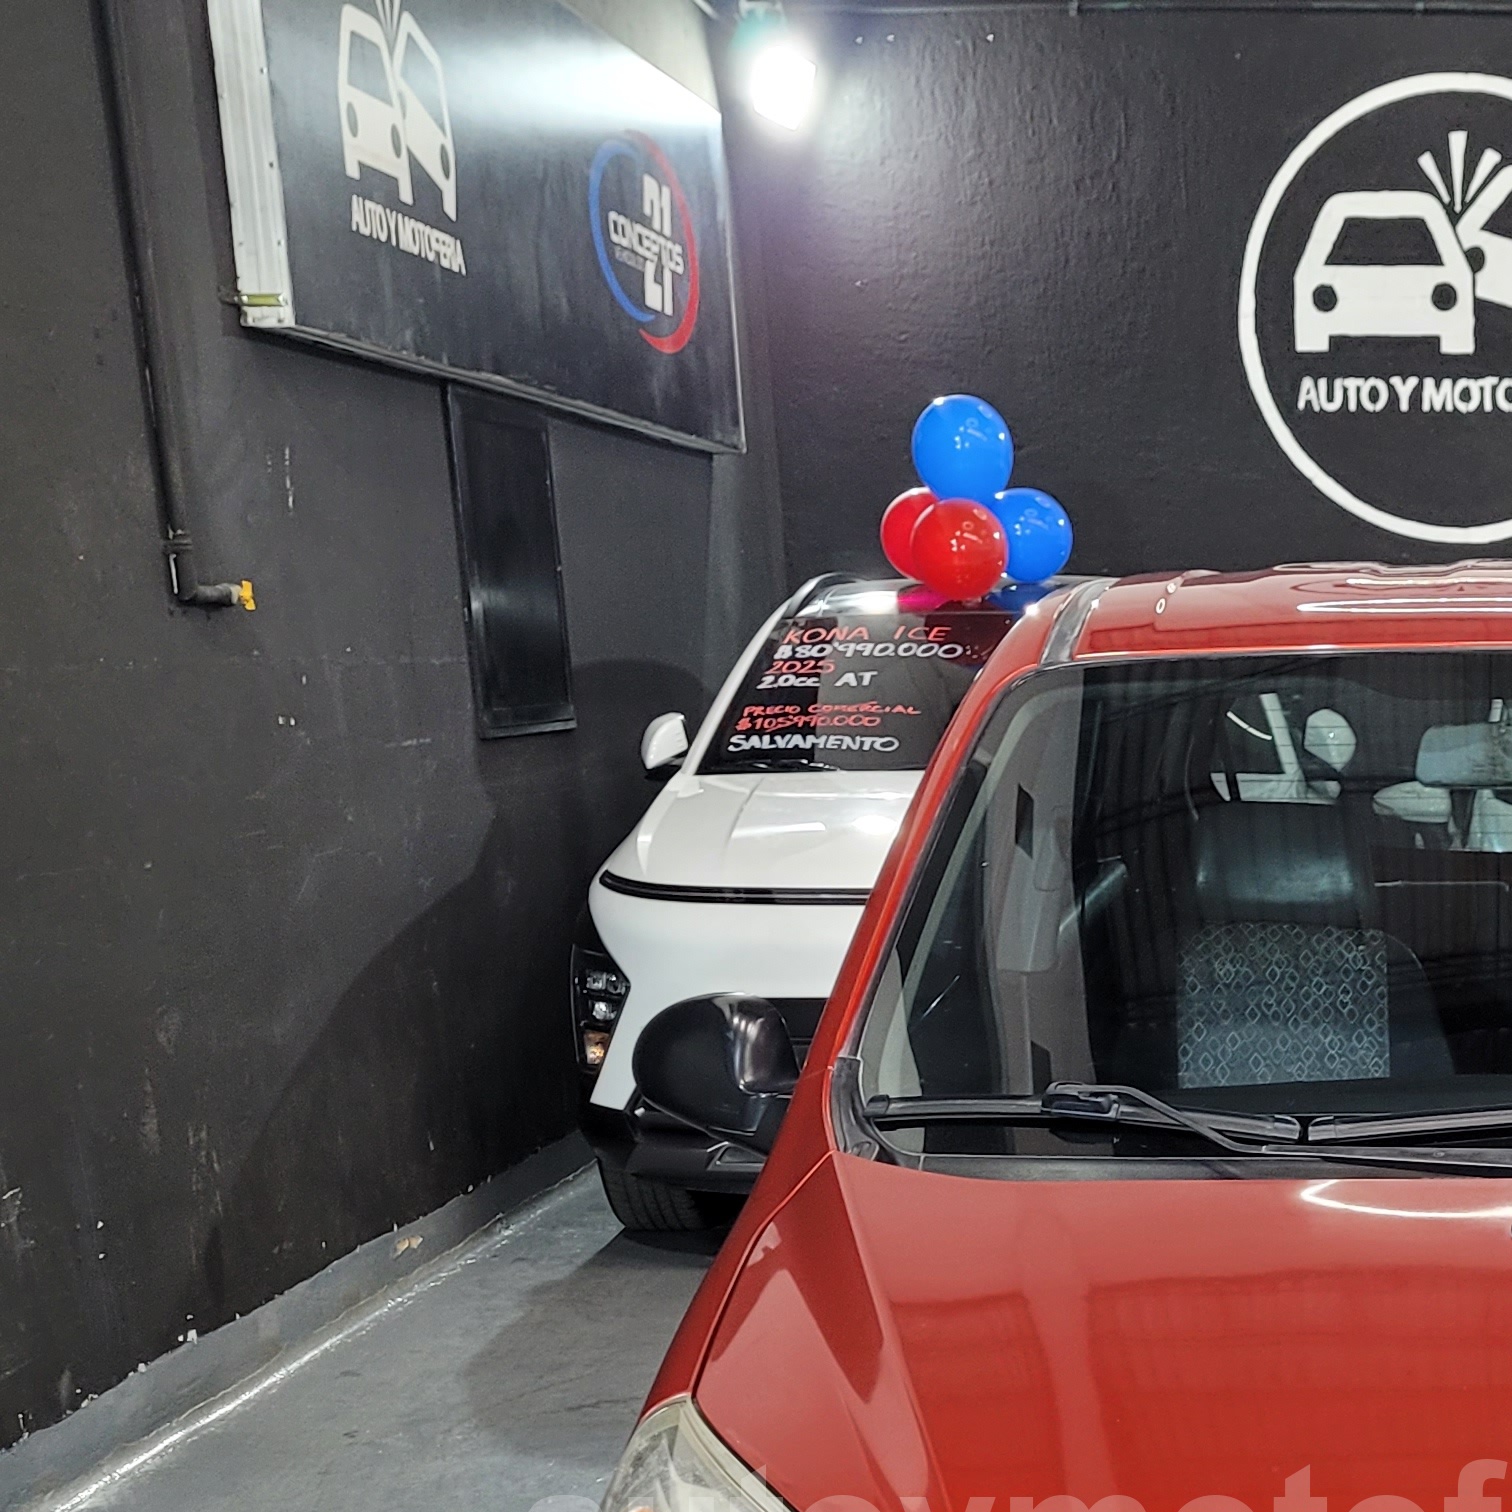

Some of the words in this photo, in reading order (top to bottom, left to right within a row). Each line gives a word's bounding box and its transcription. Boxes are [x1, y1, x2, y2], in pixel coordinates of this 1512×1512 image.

[352, 194, 388, 242] AUTO
[386, 208, 397, 247] Y
[398, 213, 466, 276] MOTOFERIA
[608, 211, 685, 274] CONCEPTOS
[1298, 376, 1389, 413] AUTO
[1390, 376, 1419, 412] Y
[783, 627, 868, 643] KONA
[894, 626, 951, 641] ICE
[765, 660, 835, 675] 2025
[834, 671, 878, 687] AT
[743, 704, 800, 716] PRECIO
[807, 701, 921, 715] COMERCIAL
[728, 734, 899, 751] SALVAMENTO
